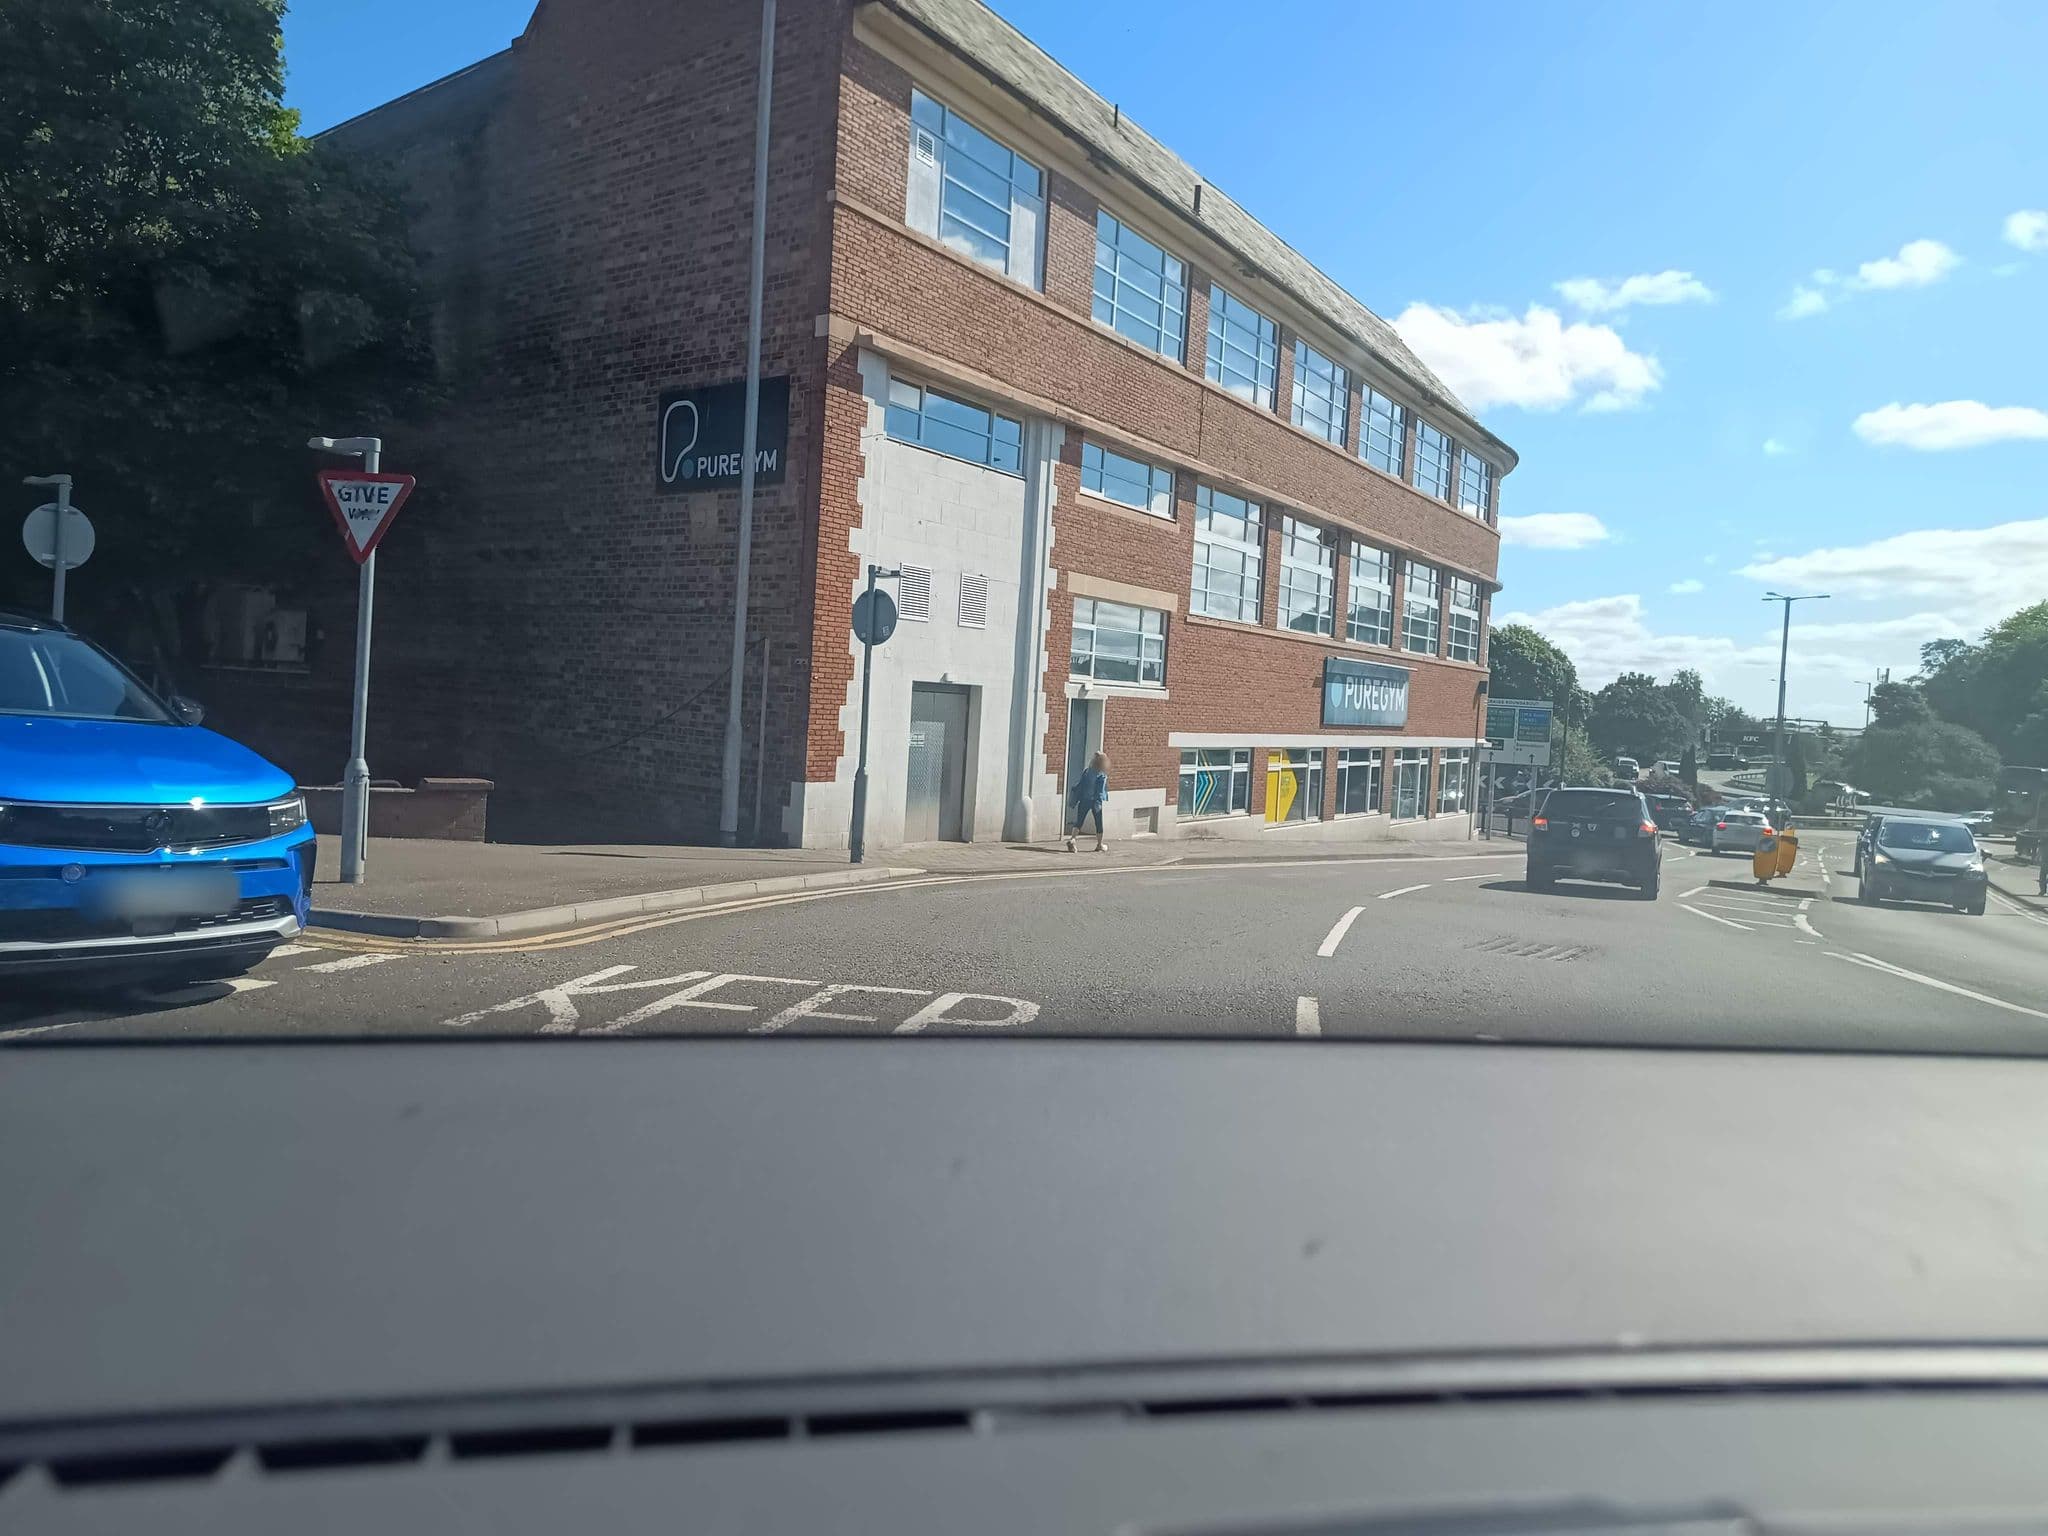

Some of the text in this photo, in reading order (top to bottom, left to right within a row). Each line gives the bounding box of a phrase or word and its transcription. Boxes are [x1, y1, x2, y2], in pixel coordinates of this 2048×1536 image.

[697, 449, 778, 478] PUREYM
[338, 486, 389, 504] GIVE
[1345, 676, 1406, 712] PUREGYM
[439, 964, 1041, 1035] KEEP
